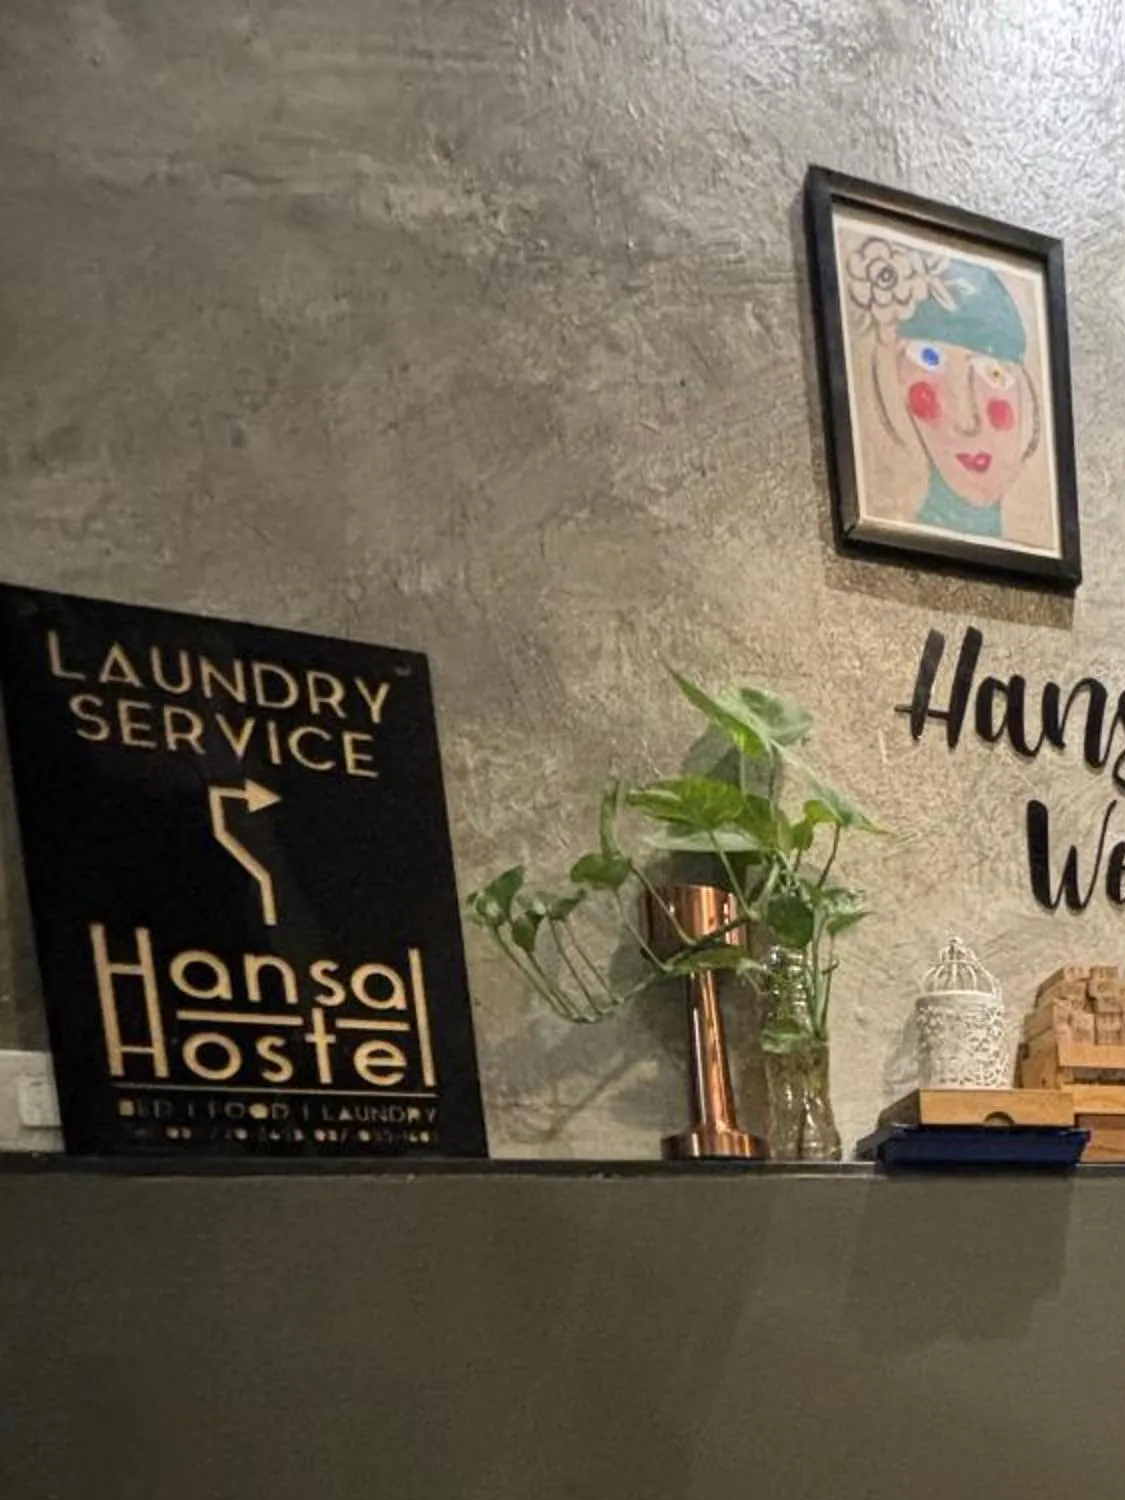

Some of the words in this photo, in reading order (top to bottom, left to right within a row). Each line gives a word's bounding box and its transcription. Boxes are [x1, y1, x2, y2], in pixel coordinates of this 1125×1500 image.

[49, 632, 390, 724] LAUNDRY
[69, 694, 379, 778] SERVICE
[321, 1102, 438, 1123] LAUNDRY
